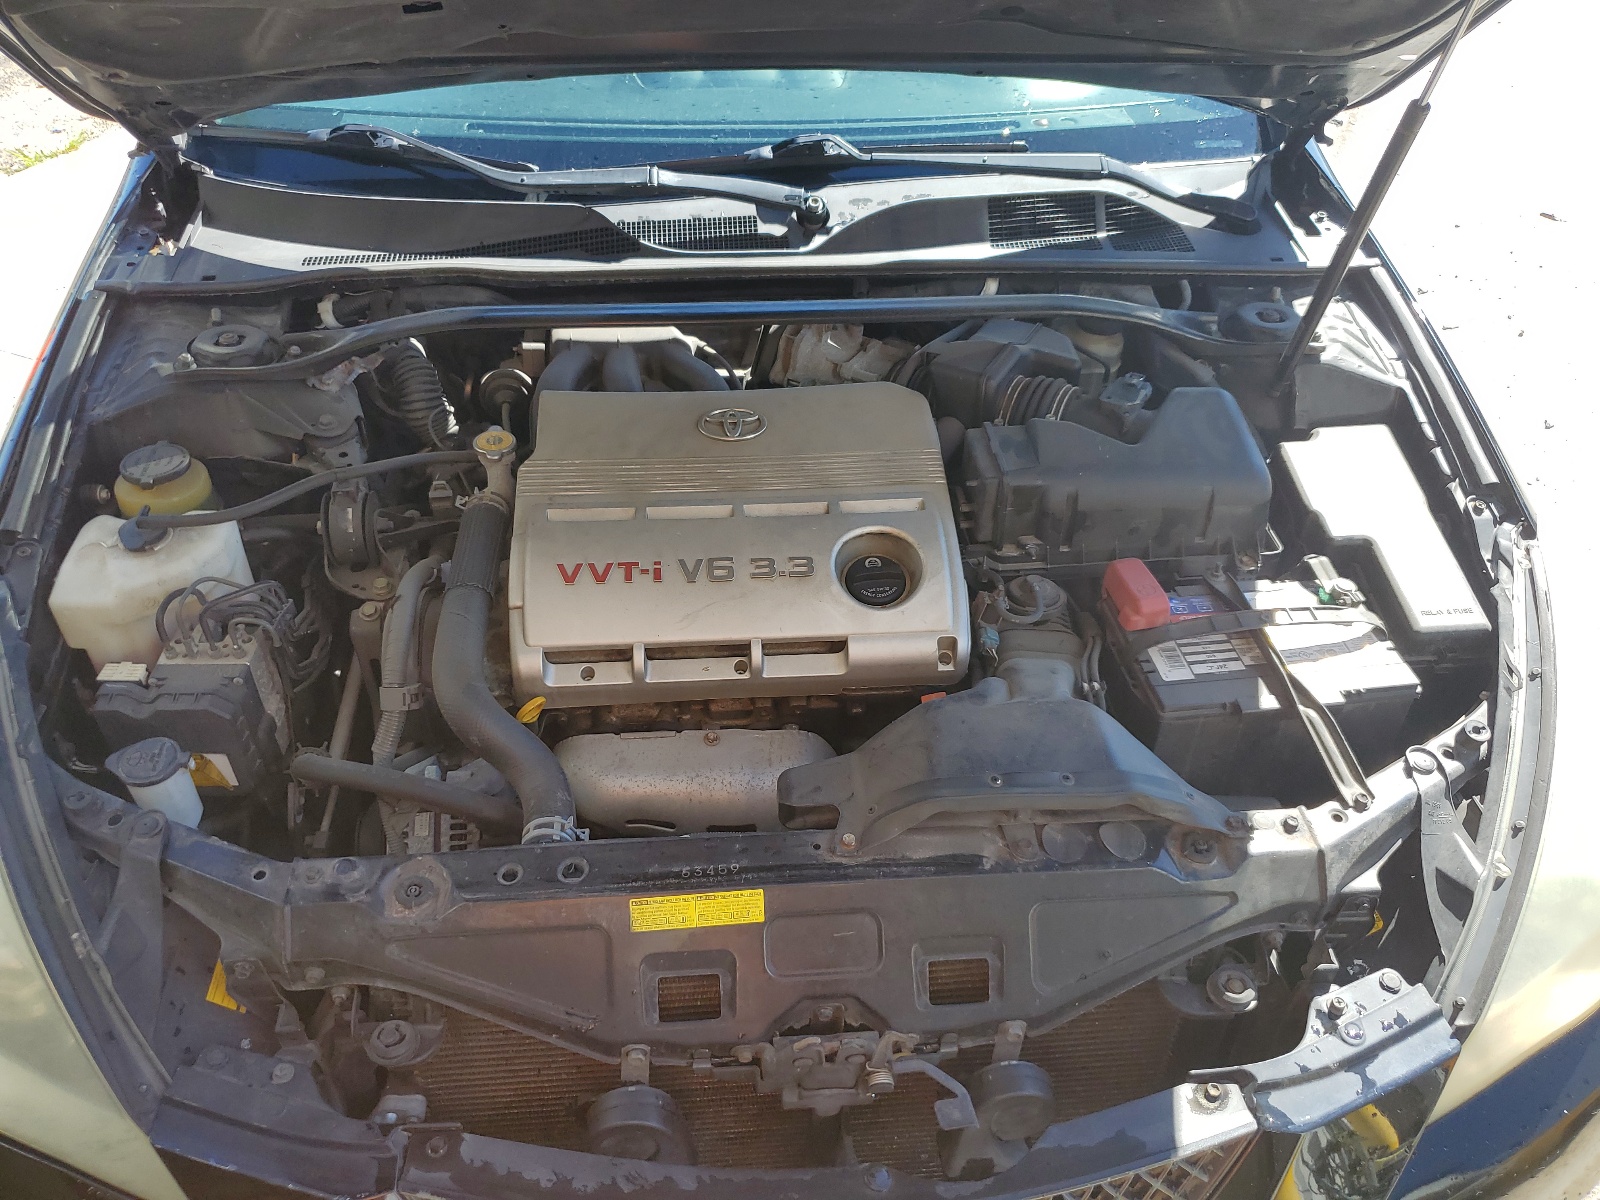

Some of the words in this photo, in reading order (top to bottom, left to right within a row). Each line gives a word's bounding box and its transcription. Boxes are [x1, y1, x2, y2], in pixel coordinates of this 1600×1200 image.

[556, 561, 663, 585] VVT-i
[677, 557, 735, 583] V6
[750, 556, 815, 579] 3.3
[1453, 607, 1474, 615] FUSE
